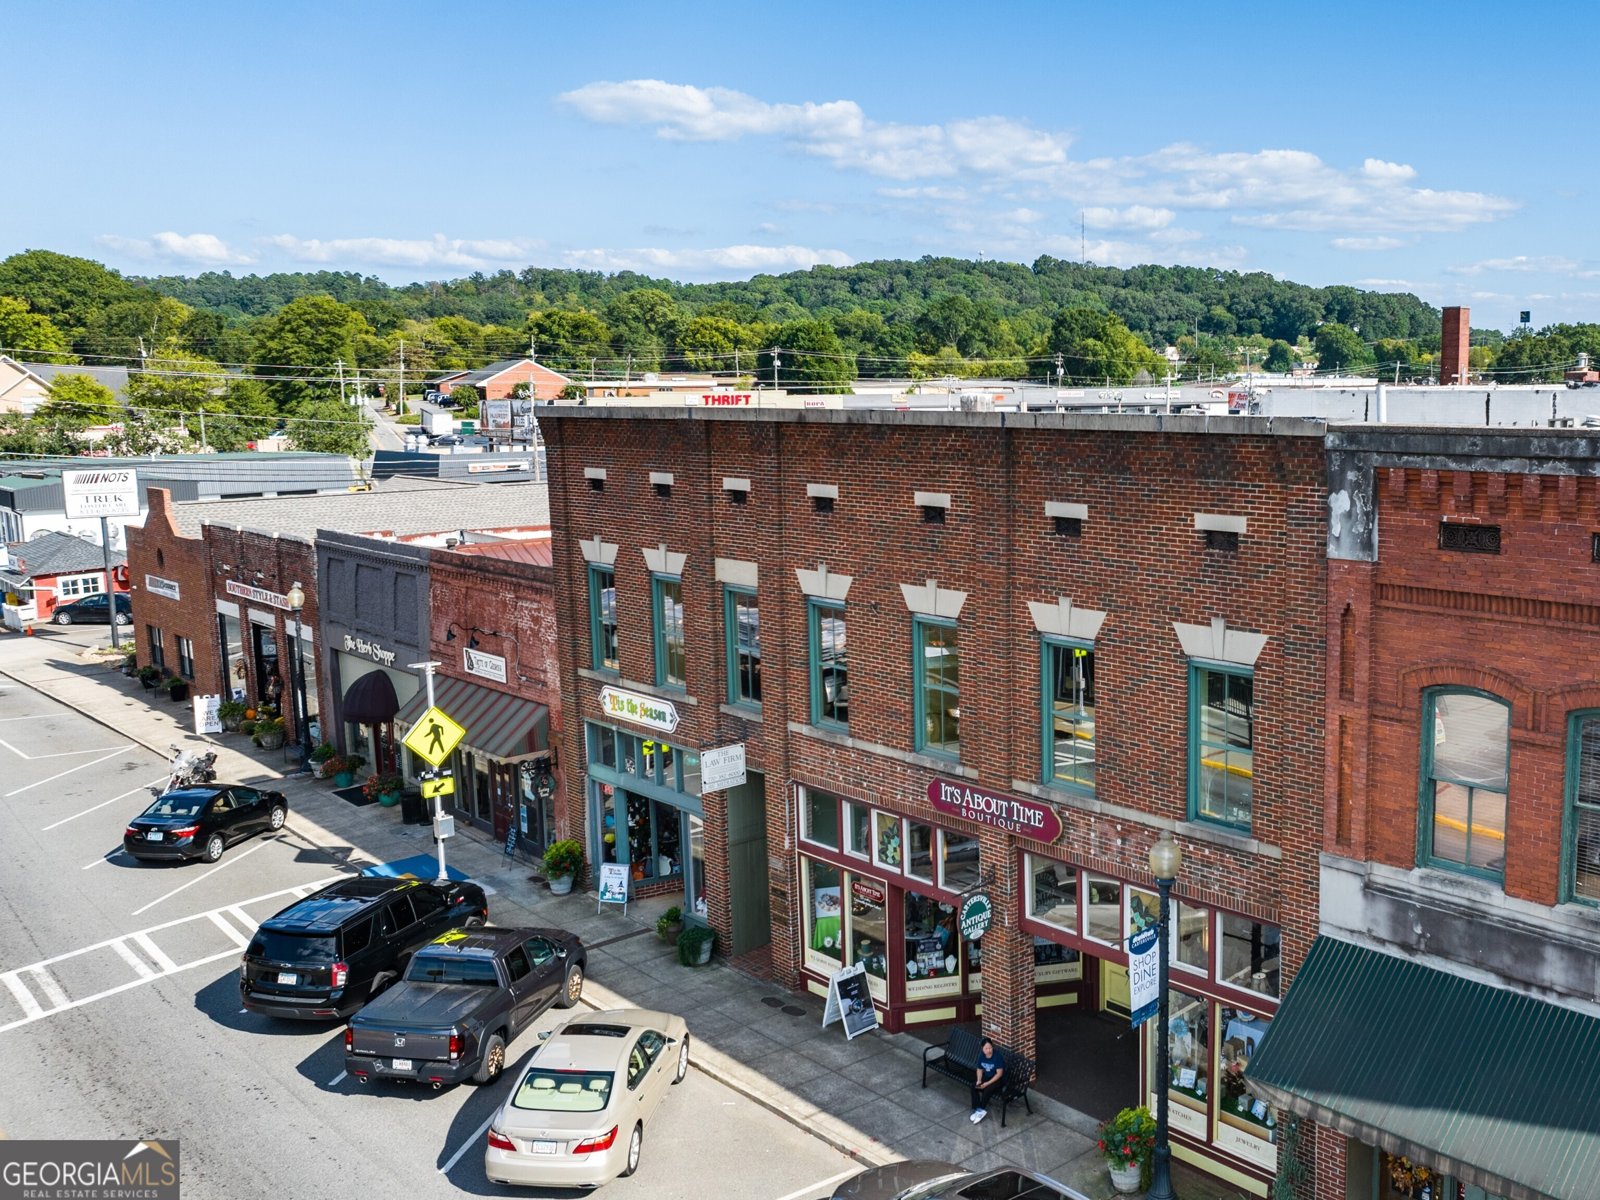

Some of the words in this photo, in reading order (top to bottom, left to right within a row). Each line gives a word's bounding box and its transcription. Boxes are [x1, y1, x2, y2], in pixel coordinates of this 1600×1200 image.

[702, 395, 752, 406] THRIFT
[100, 472, 130, 483] NOTS
[344, 634, 356, 651] The
[356, 638, 372, 655] Herb
[372, 643, 396, 667] Shoppe
[626, 698, 638, 715] the
[639, 702, 667, 723] Season
[704, 759, 720, 768] LAW
[723, 754, 742, 764] FIRM
[941, 783, 961, 804] IT'S
[962, 788, 1008, 818] ABOUT
[1010, 801, 1044, 828] TIME
[961, 808, 1021, 833] BOUTIQUE
[960, 894, 991, 920] CARTERSVILLE
[961, 909, 991, 929] ANTIQUE
[963, 919, 989, 936] GALLERY
[1133, 951, 1157, 972] SHOP
[1133, 963, 1157, 985] DINE
[1134, 976, 1157, 995] EXPLORE
[1235, 1136, 1261, 1151] JEWELRY
